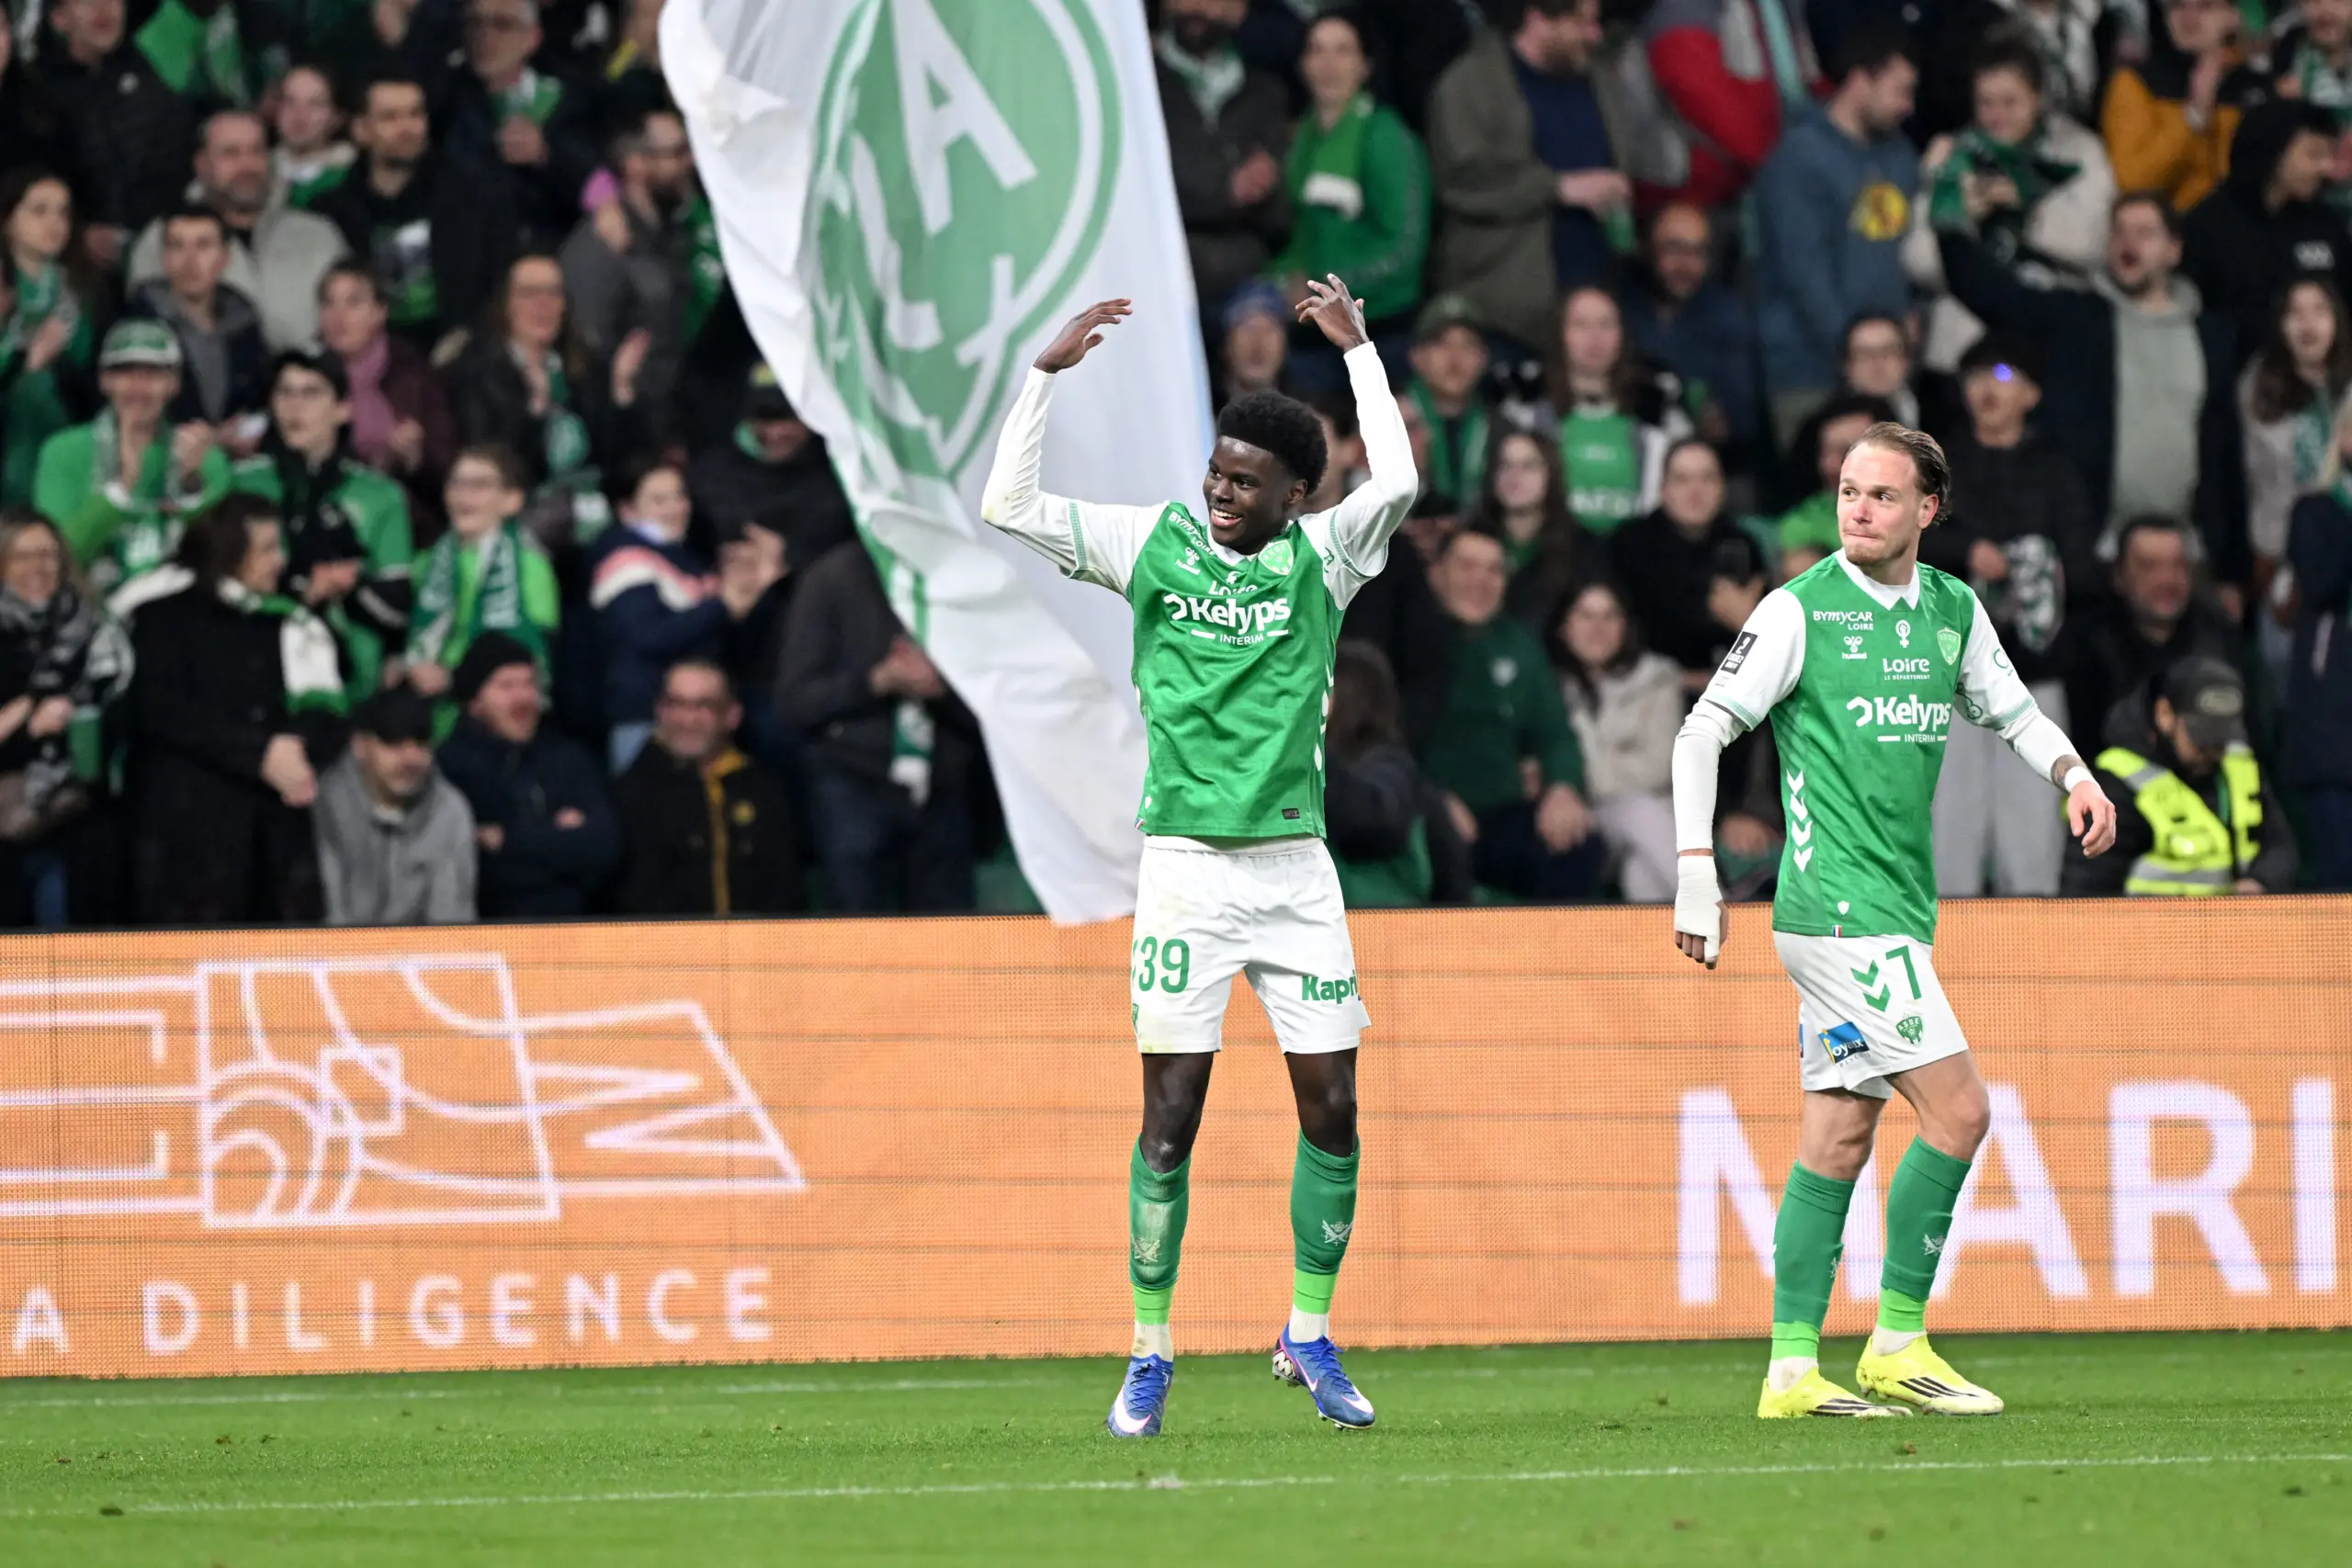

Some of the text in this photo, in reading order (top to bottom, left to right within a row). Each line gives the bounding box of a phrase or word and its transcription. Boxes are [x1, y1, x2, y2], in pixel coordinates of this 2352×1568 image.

[1187, 597, 1291, 636] Kelyps
[1219, 633, 1264, 646] INTERIM
[1883, 658, 1930, 672] Loire
[1873, 694, 1952, 732] Kelyps
[1904, 733, 1936, 743] INTERIM
[1138, 935, 1191, 994] 39
[1885, 944, 1923, 1000] 7
[141, 1265, 774, 1357] DILIGENCE
